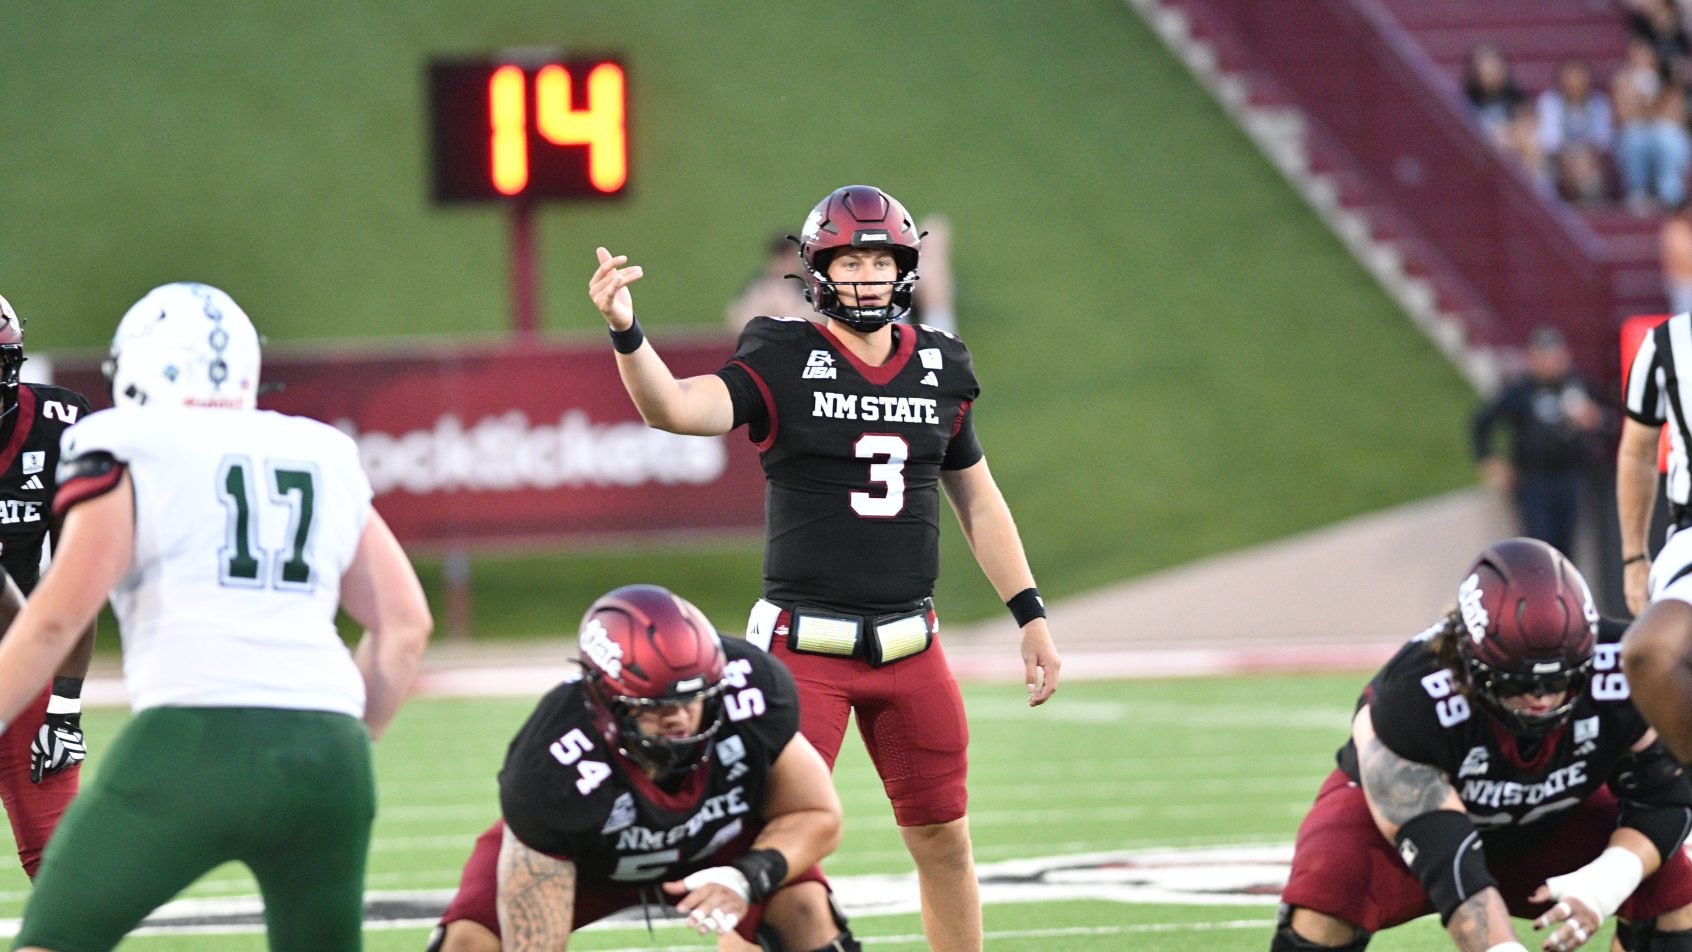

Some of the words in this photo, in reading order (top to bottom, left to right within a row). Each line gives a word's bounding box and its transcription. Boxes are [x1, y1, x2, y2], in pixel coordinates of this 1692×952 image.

[489, 63, 628, 195] 14
[802, 367, 837, 380] USA
[43, 400, 78, 425] 2
[812, 391, 858, 419] NM
[861, 396, 939, 424] STATE
[849, 432, 910, 518] 3
[217, 454, 320, 593] 17
[723, 658, 766, 722] 54
[1421, 668, 1472, 728] 69
[1591, 643, 1631, 700] 69
[550, 728, 612, 795] 54
[1462, 779, 1506, 808] NM
[616, 826, 665, 850] NM
